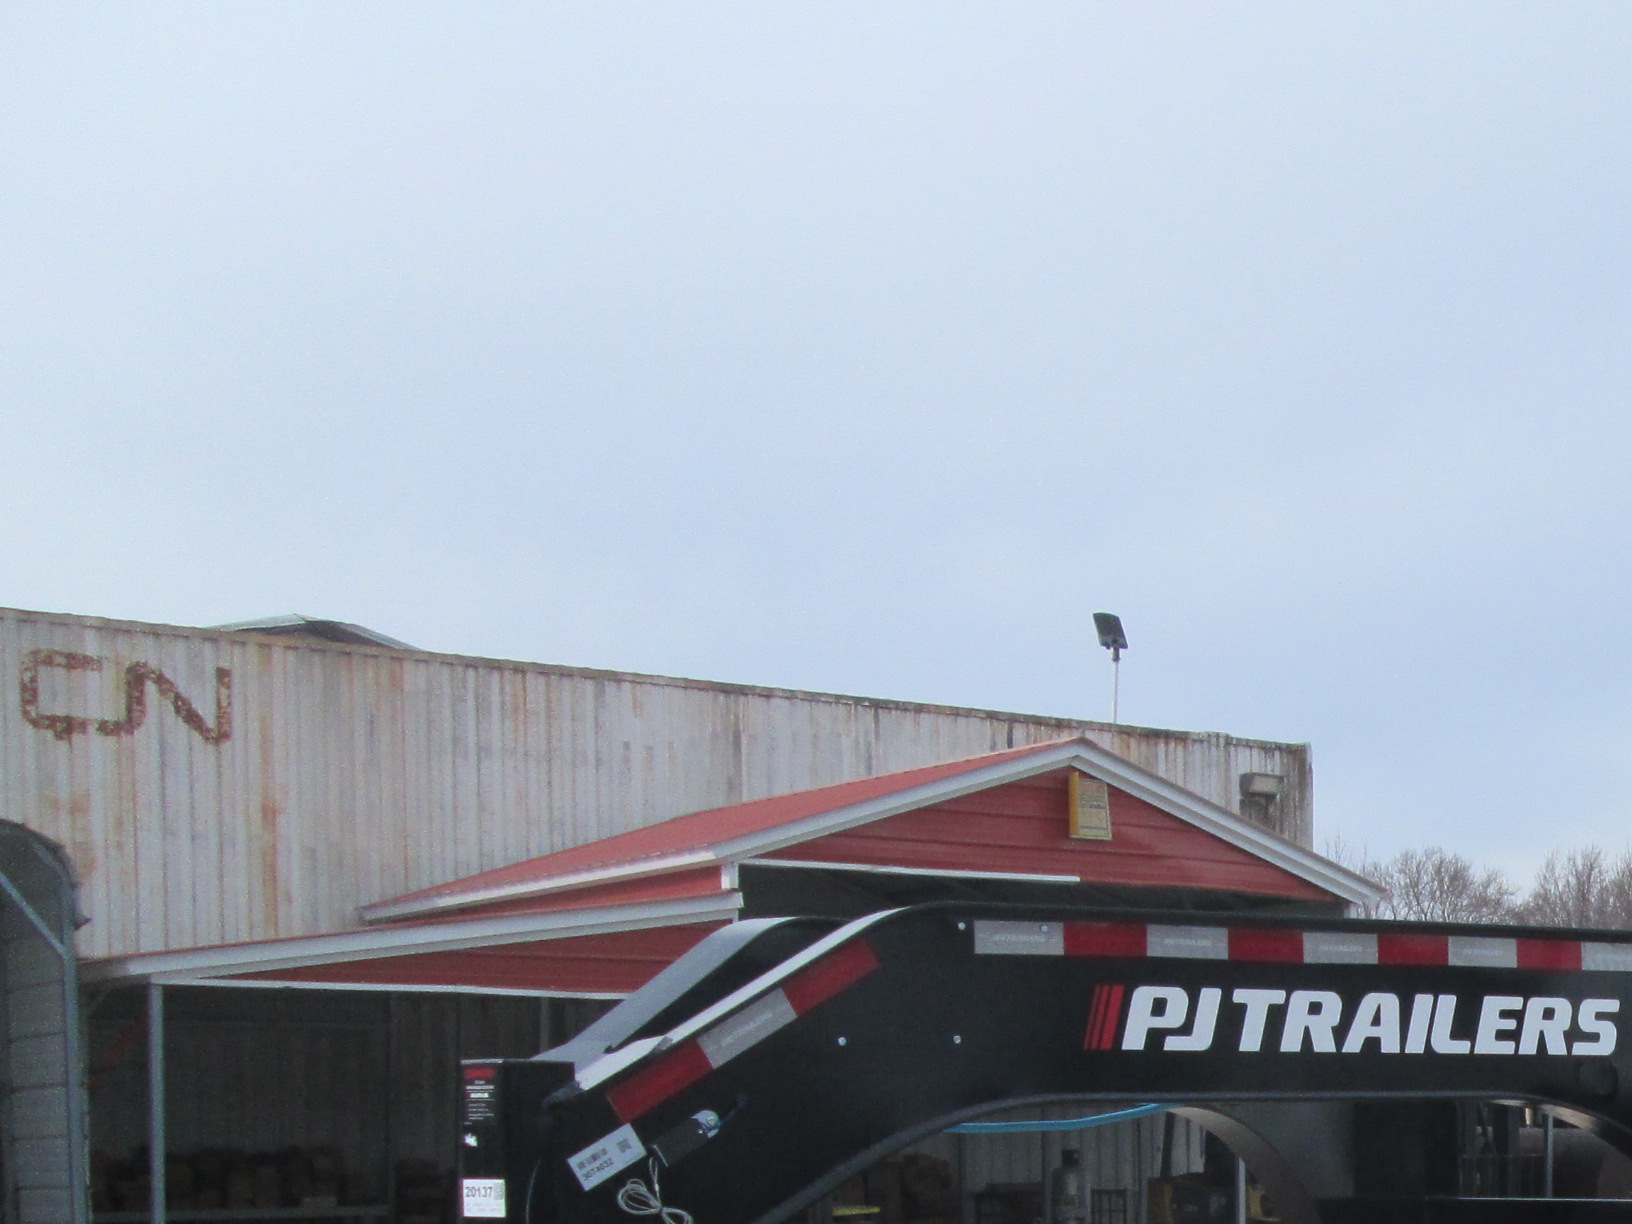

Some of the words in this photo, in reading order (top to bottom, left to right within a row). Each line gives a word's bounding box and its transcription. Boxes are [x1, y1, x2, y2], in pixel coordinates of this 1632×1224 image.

[20, 649, 232, 745] CN
[1121, 985, 1222, 1051] PJ
[1232, 988, 1620, 1056] TRAILERS
